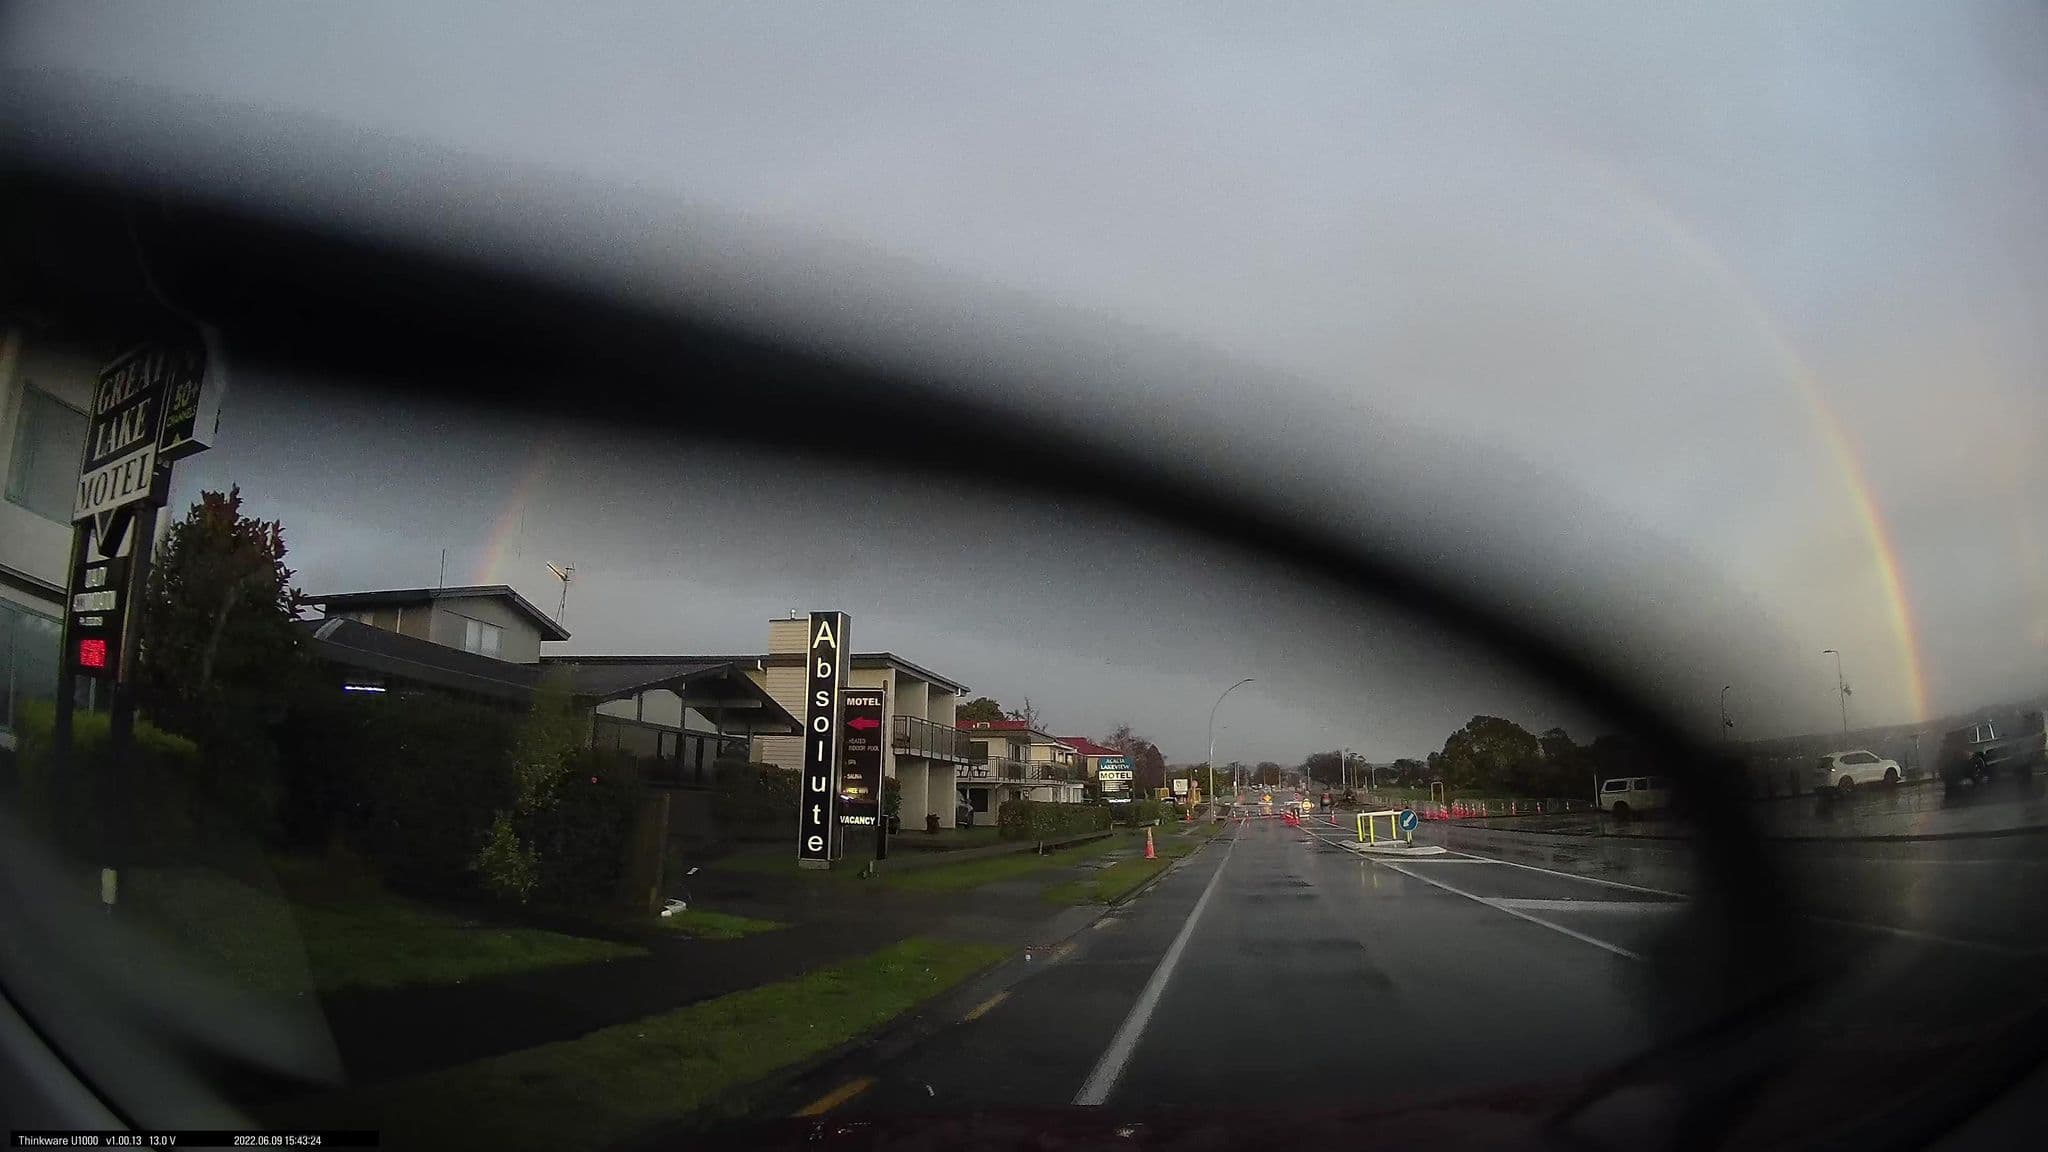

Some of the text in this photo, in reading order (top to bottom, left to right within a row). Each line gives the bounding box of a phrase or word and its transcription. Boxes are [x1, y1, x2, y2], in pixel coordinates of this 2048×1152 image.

[92, 397, 153, 461] LAKE
[80, 453, 150, 509] MOTEL
[846, 697, 881, 706] MOTEL
[807, 620, 837, 852] Absolute
[840, 815, 876, 825] VACANCY
